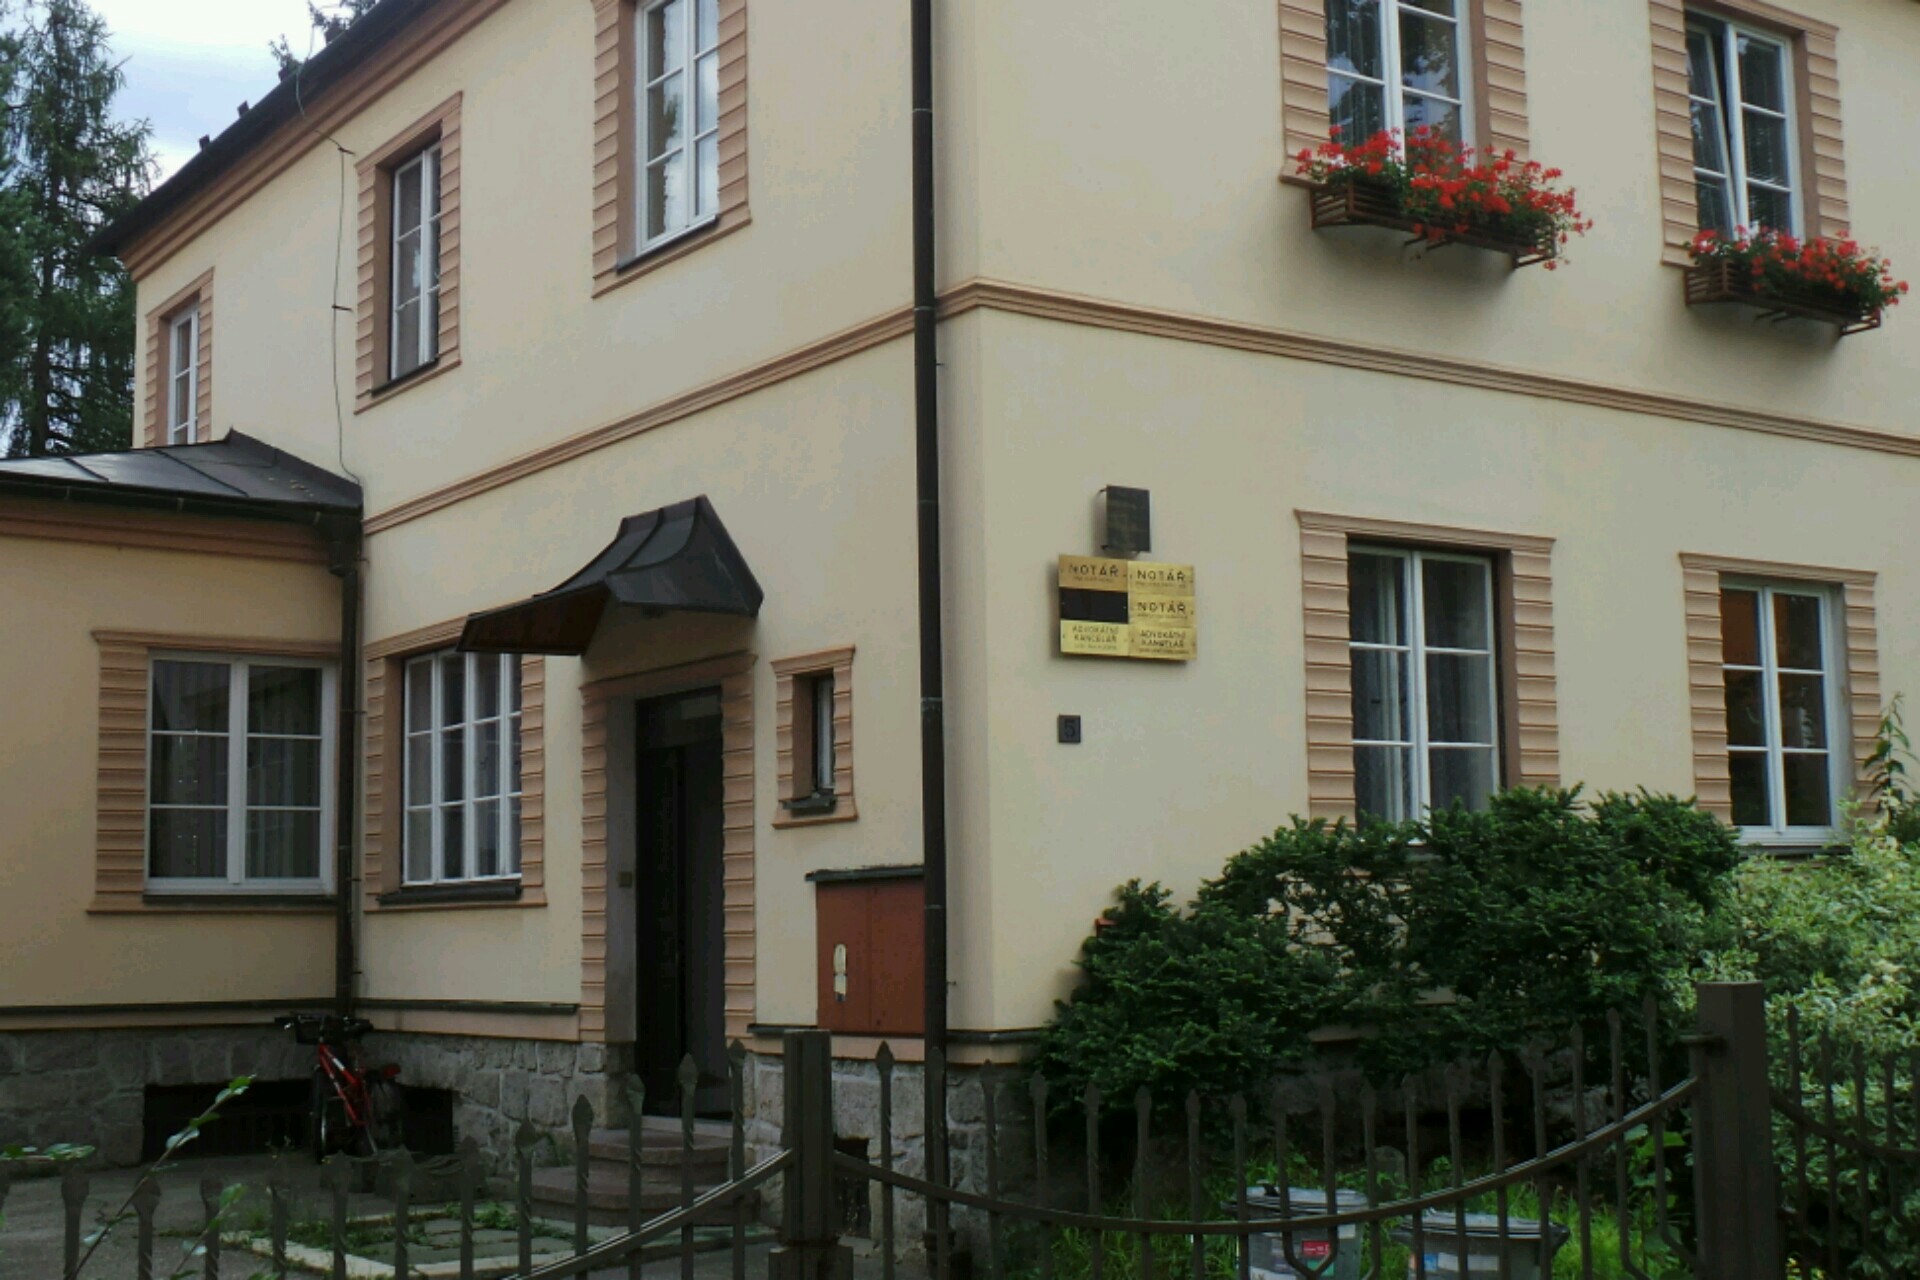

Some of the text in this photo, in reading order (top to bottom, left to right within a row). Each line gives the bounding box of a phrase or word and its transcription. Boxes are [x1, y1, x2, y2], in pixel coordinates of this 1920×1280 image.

[1069, 563, 1118, 576] NOTÁŘ
[1137, 568, 1184, 582] NOTÁŘ
[1137, 600, 1185, 613] NOTÁŘ
